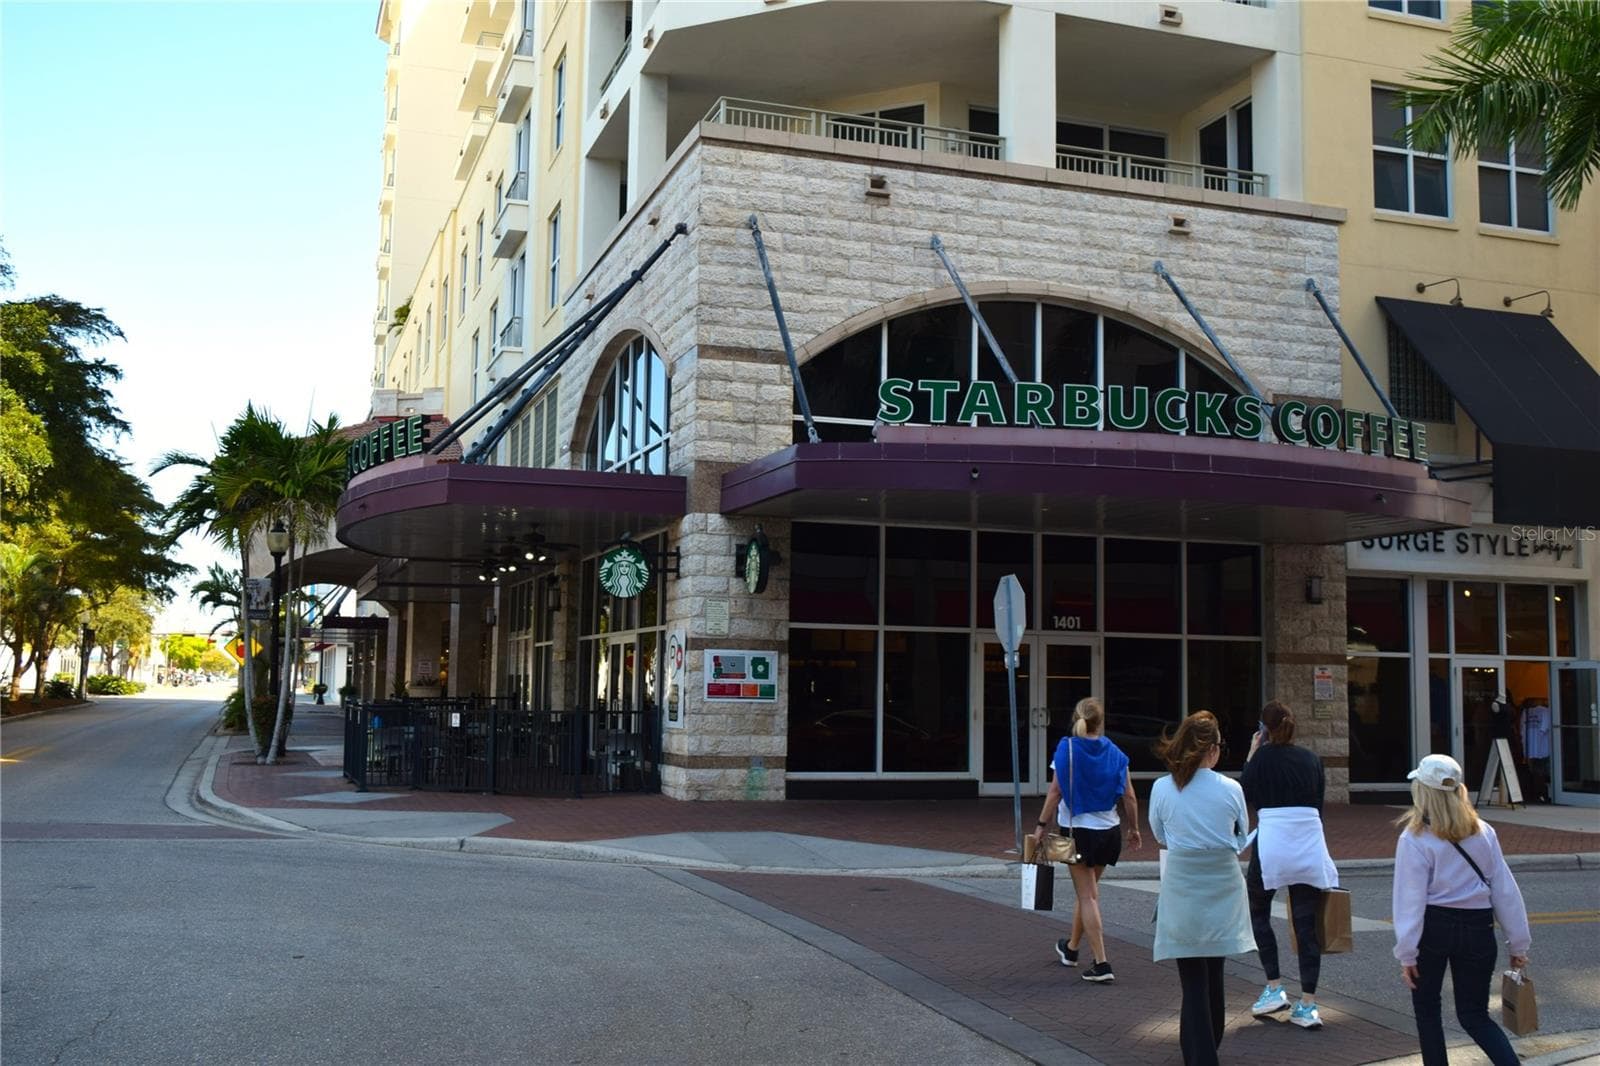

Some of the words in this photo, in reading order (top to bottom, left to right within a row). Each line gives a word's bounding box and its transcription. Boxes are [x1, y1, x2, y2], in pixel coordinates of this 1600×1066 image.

[877, 378, 1264, 439] STARBUCKS
[1277, 400, 1429, 462] COFFEE
[351, 415, 423, 474] COFFEE
[1456, 533, 1529, 557] STYLE
[1053, 616, 1081, 629] 1401
